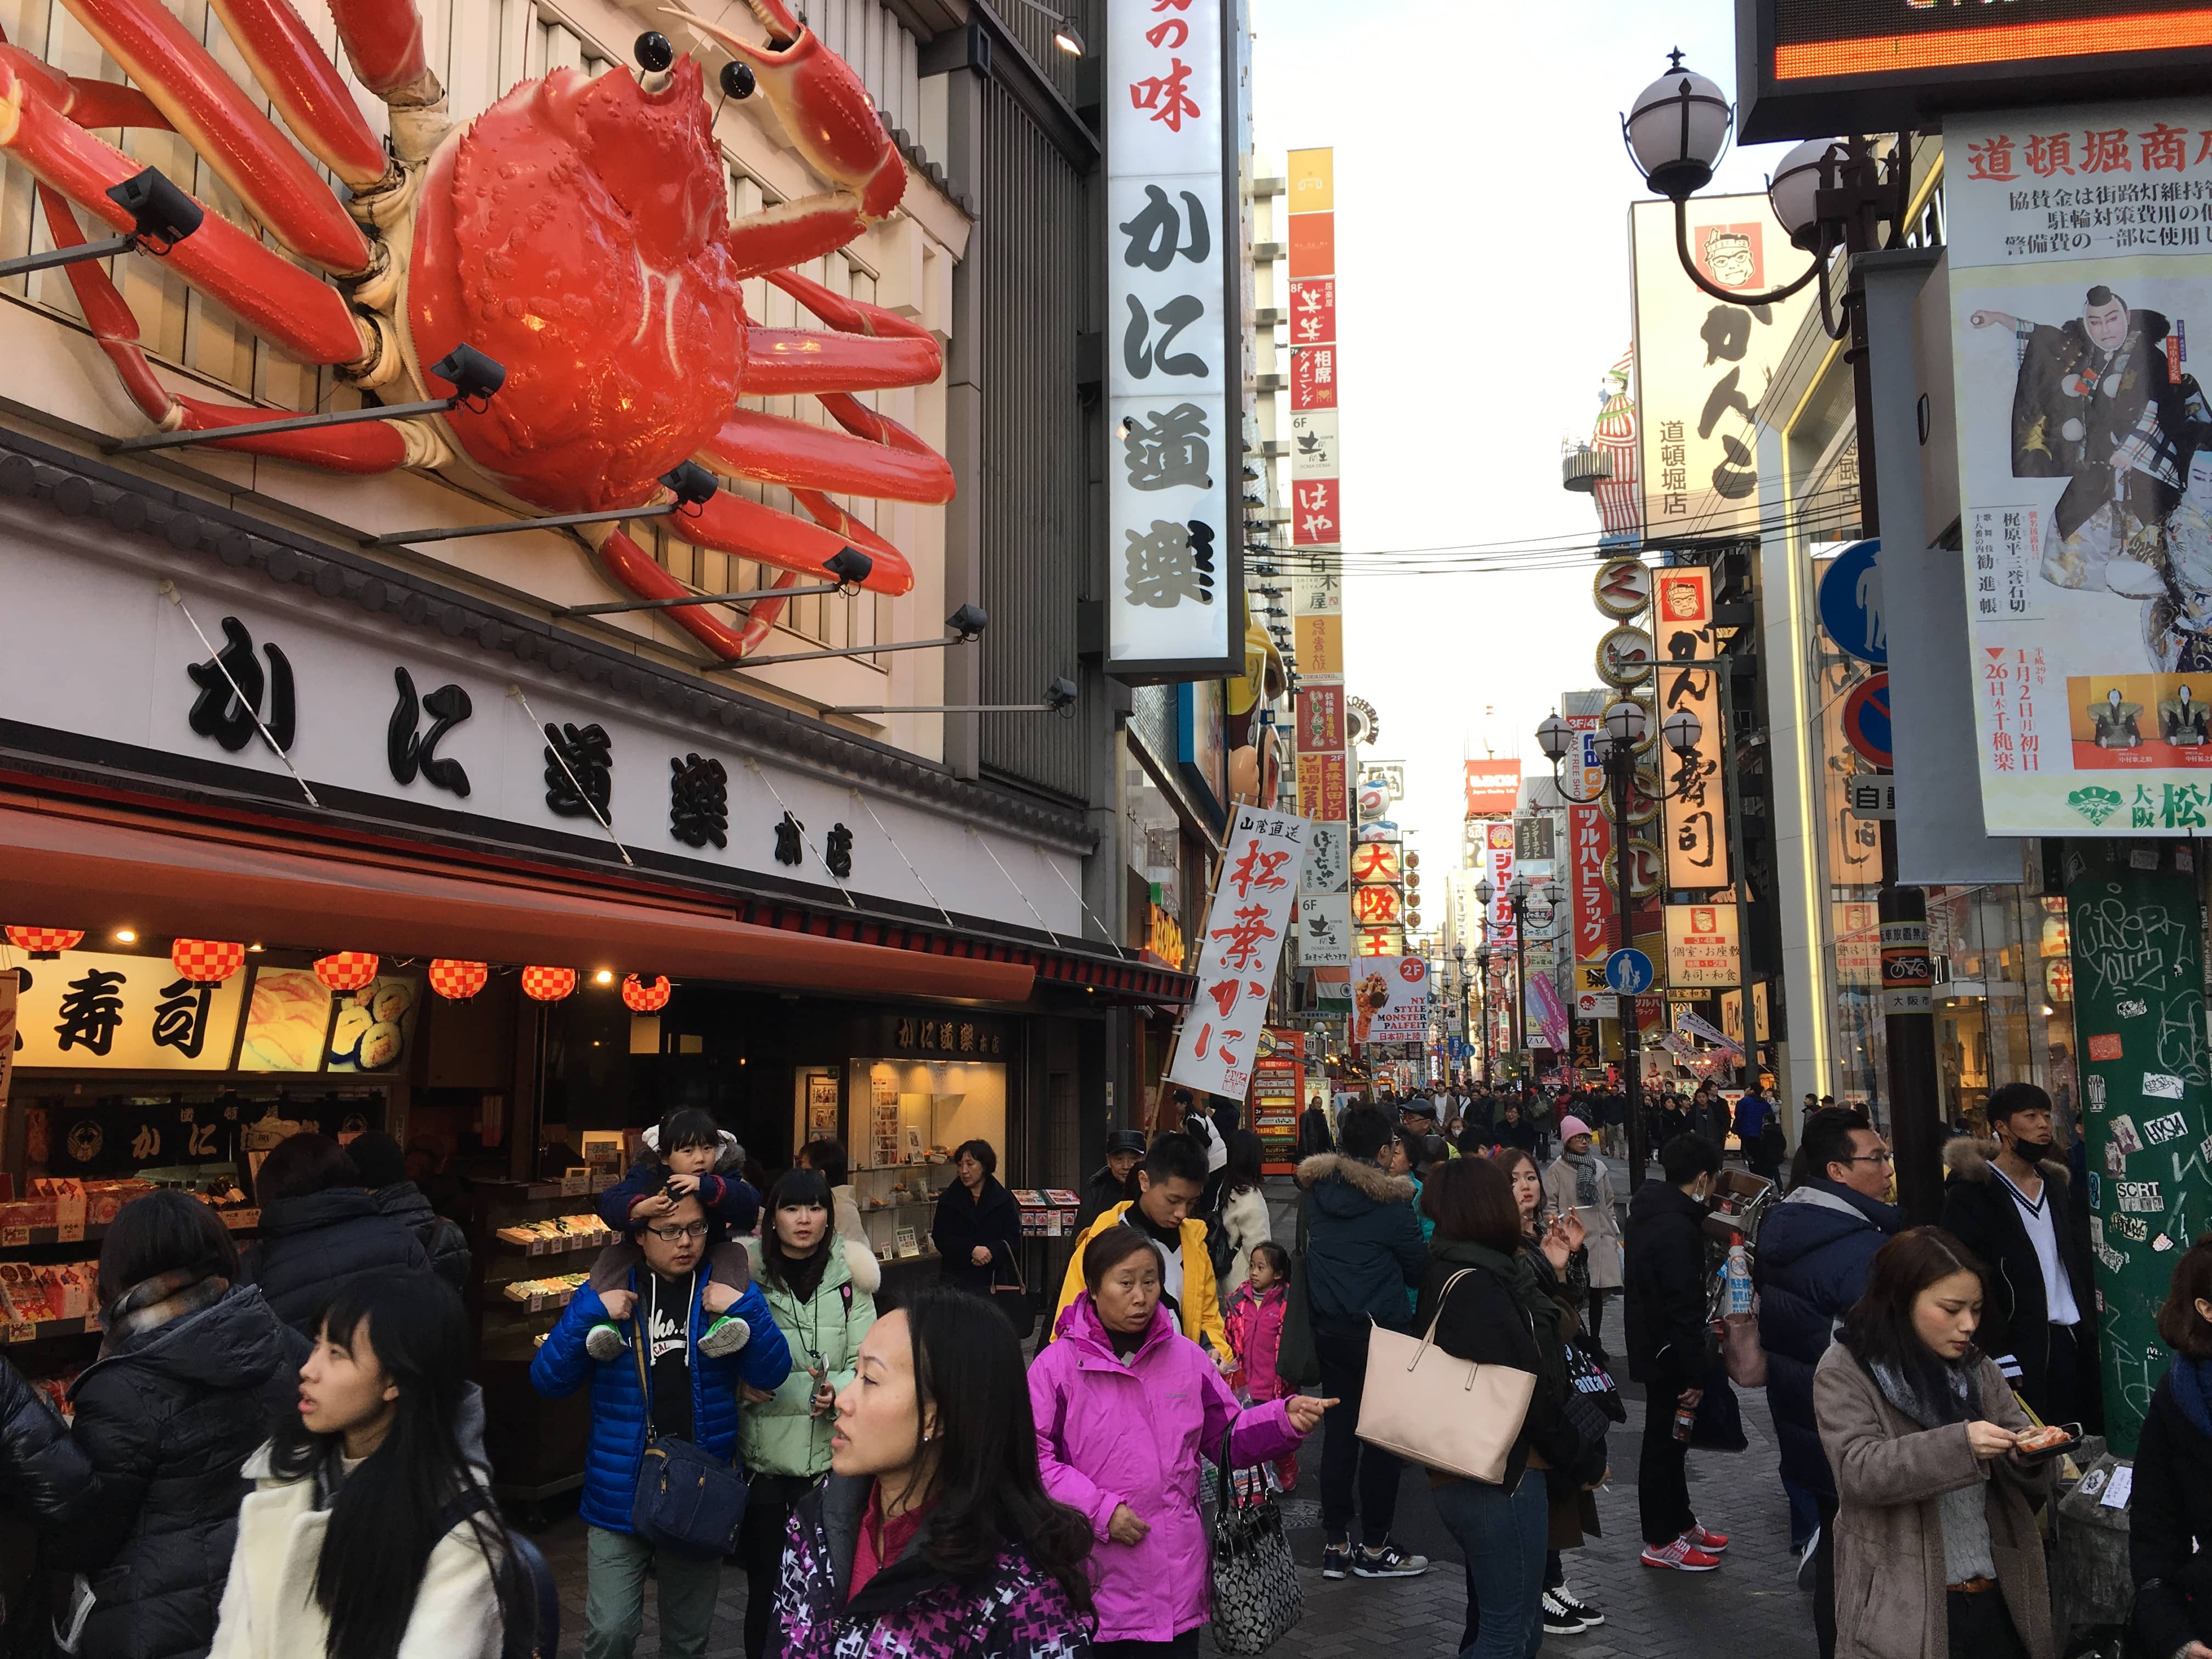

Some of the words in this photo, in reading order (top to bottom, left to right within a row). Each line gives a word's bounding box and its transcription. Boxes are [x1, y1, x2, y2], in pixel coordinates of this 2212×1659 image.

[1130, 0, 1201, 132] の味
[1290, 283, 1303, 293] 8F
[1299, 350, 1313, 407] ダイニング
[1314, 350, 1332, 383] 相席
[1293, 417, 1307, 428] 6F
[1660, 420, 1688, 515] 道頓堀店
[1299, 483, 1333, 541] はや
[1983, 514, 1994, 552] 歌舞伎
[1977, 554, 1997, 614] 勧進帳
[2130, 783, 2155, 828] 大阪
[2159, 782, 2212, 828] 松
[1531, 819, 1541, 858] インターネット
[1578, 809, 1605, 942] ツルハドラッグ
[1303, 899, 1317, 911] 6F
[1194, 839, 1292, 1066] 松葉かに
[1403, 964, 1423, 976] 2F
[1933, 956, 1943, 984] 21
[1394, 1005, 1426, 1013] STYLE
[1894, 996, 1929, 1007] 大阪市
